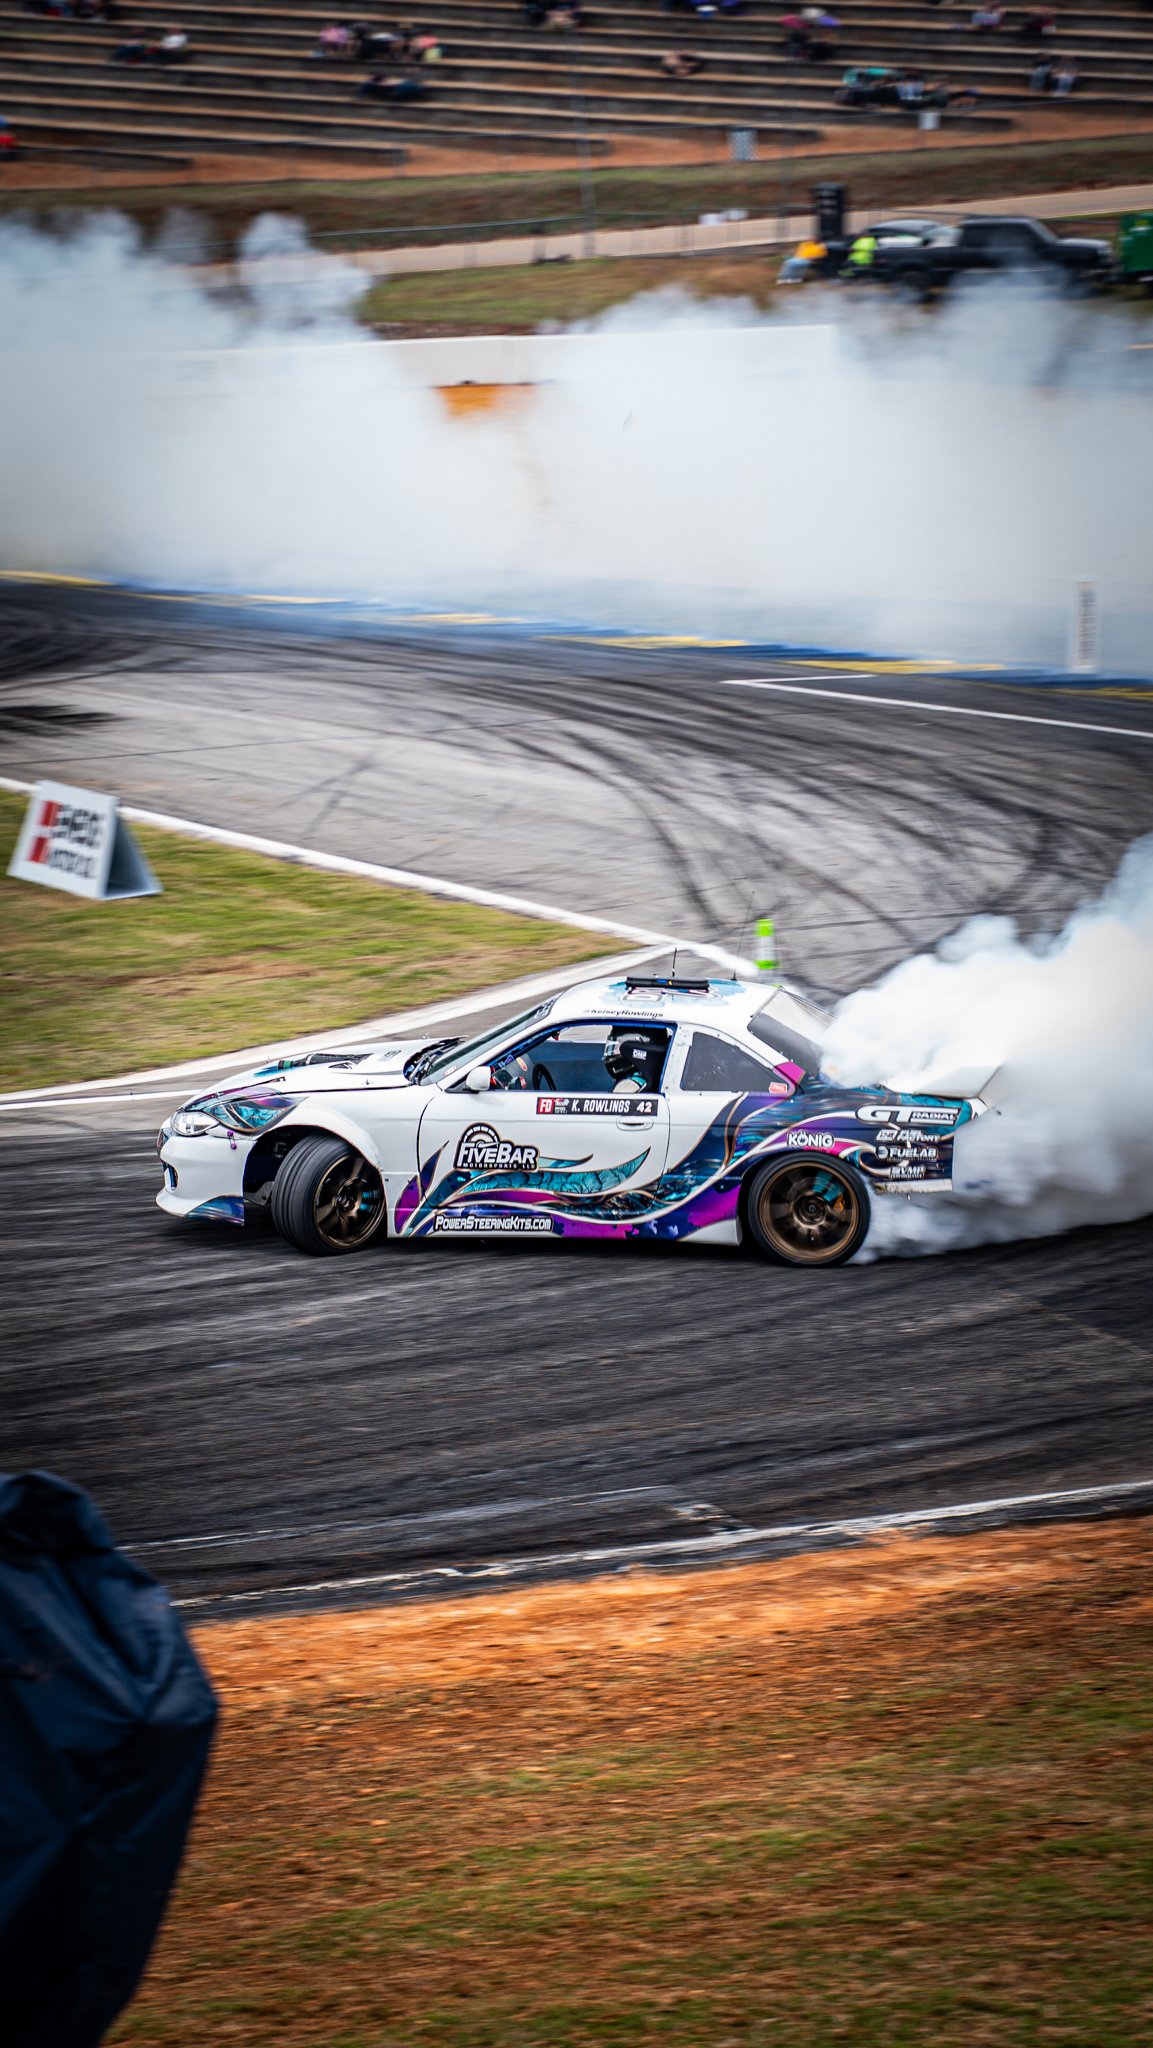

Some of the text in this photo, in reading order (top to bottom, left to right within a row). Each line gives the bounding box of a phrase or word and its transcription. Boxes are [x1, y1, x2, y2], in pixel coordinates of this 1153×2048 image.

[540, 1099, 553, 1113] FD
[571, 1099, 581, 1112] K.
[583, 1100, 631, 1113] ROWLINGS
[636, 1101, 652, 1113] 42
[911, 1112, 956, 1120] RADIAL
[788, 1131, 833, 1148] KÖNIG
[889, 1147, 937, 1158] FUELAB
